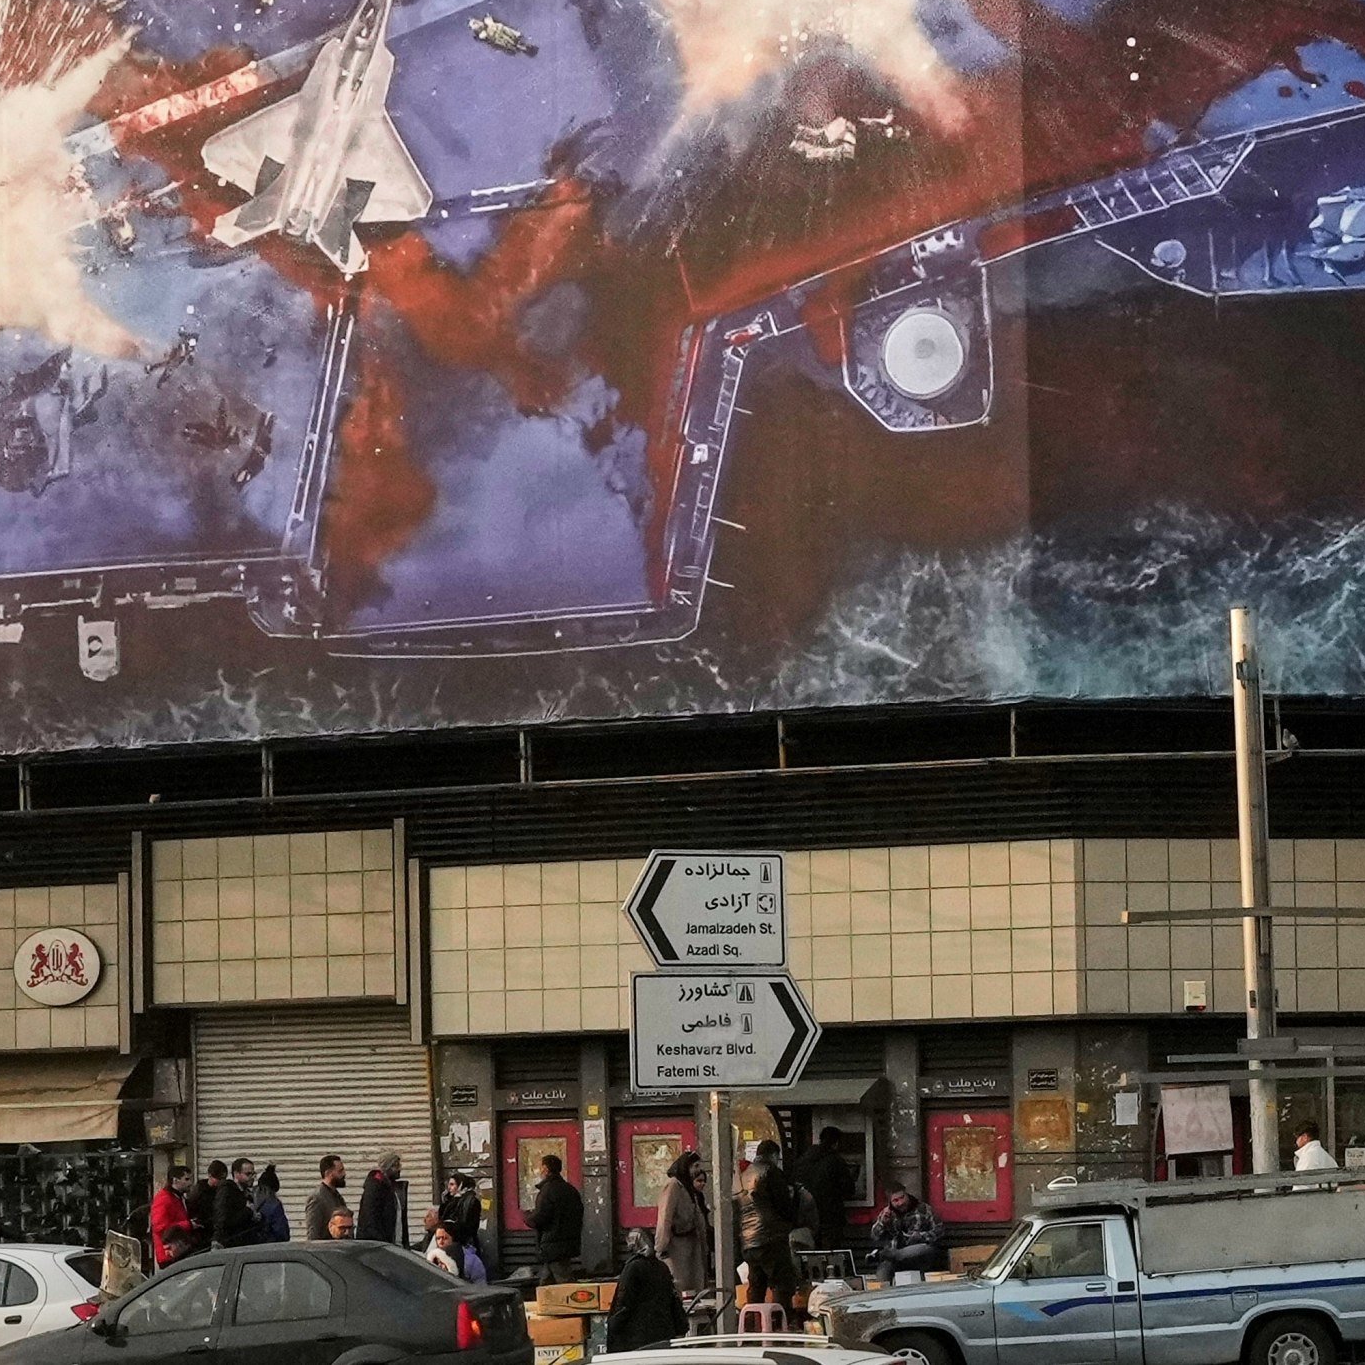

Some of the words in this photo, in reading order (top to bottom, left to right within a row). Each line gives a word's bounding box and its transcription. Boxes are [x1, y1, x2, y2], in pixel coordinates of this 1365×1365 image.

[685, 862, 751, 881] جمالزاده
[705, 892, 752, 913] آزادی
[685, 922, 756, 935] Jamalzadeh
[759, 922, 776, 935] St.
[686, 944, 720, 956] Azadi
[723, 944, 742, 958] Sq.
[678, 983, 732, 1002] کشاورز
[681, 1013, 732, 1033] فاطمی
[656, 1043, 722, 1056] Keshavarz
[726, 1043, 757, 1055] Blvd.
[656, 1065, 700, 1077] Fatemi
[702, 1065, 720, 1077] St.
[521, 1089, 543, 1100] ملت
